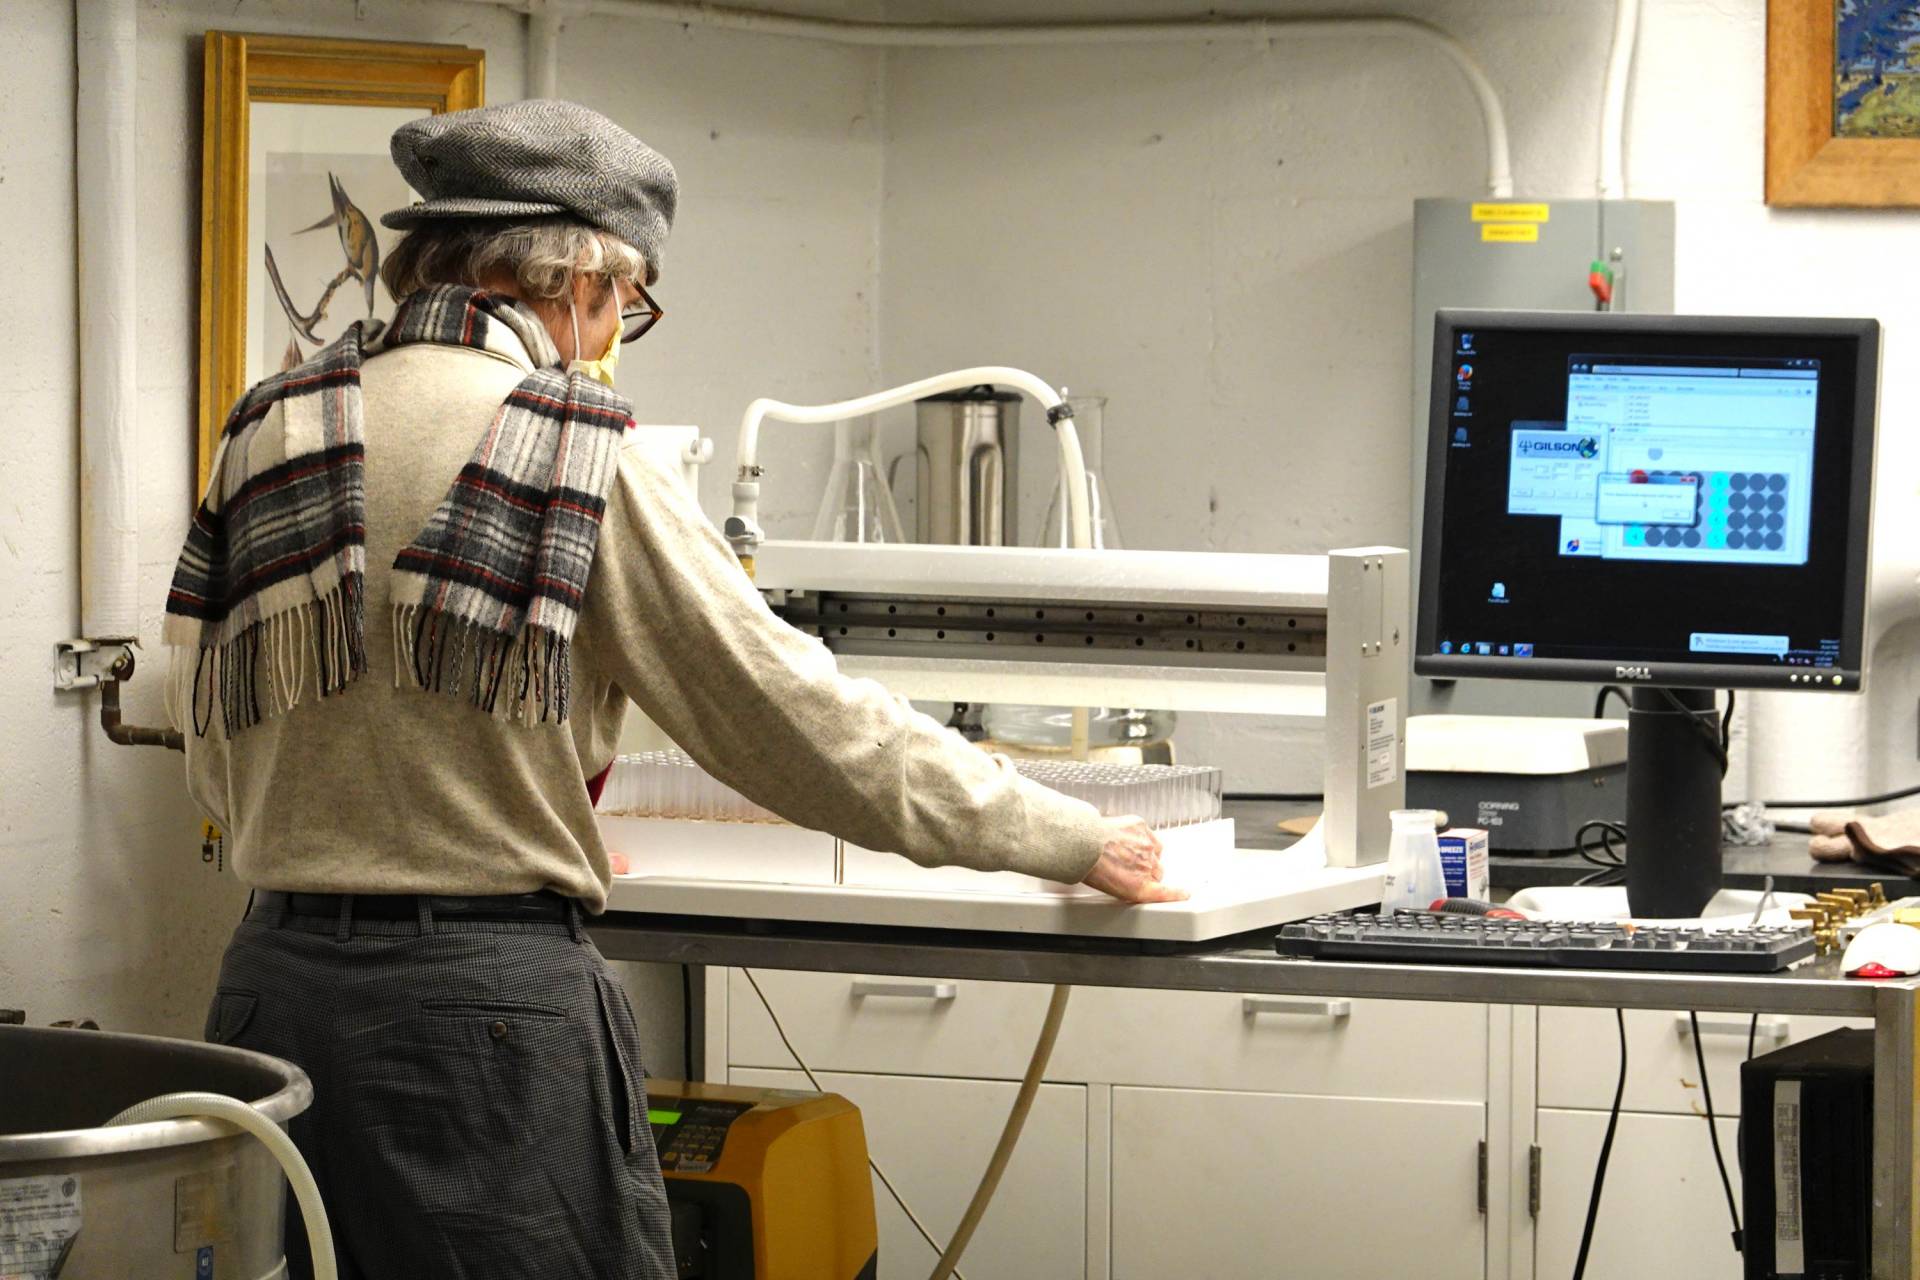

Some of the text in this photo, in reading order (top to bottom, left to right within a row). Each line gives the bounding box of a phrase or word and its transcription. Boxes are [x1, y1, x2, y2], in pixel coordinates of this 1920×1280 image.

[1533, 441, 1580, 452] GILSON
[1615, 666, 1652, 679] DELL
[1478, 801, 1520, 811] CORNING
